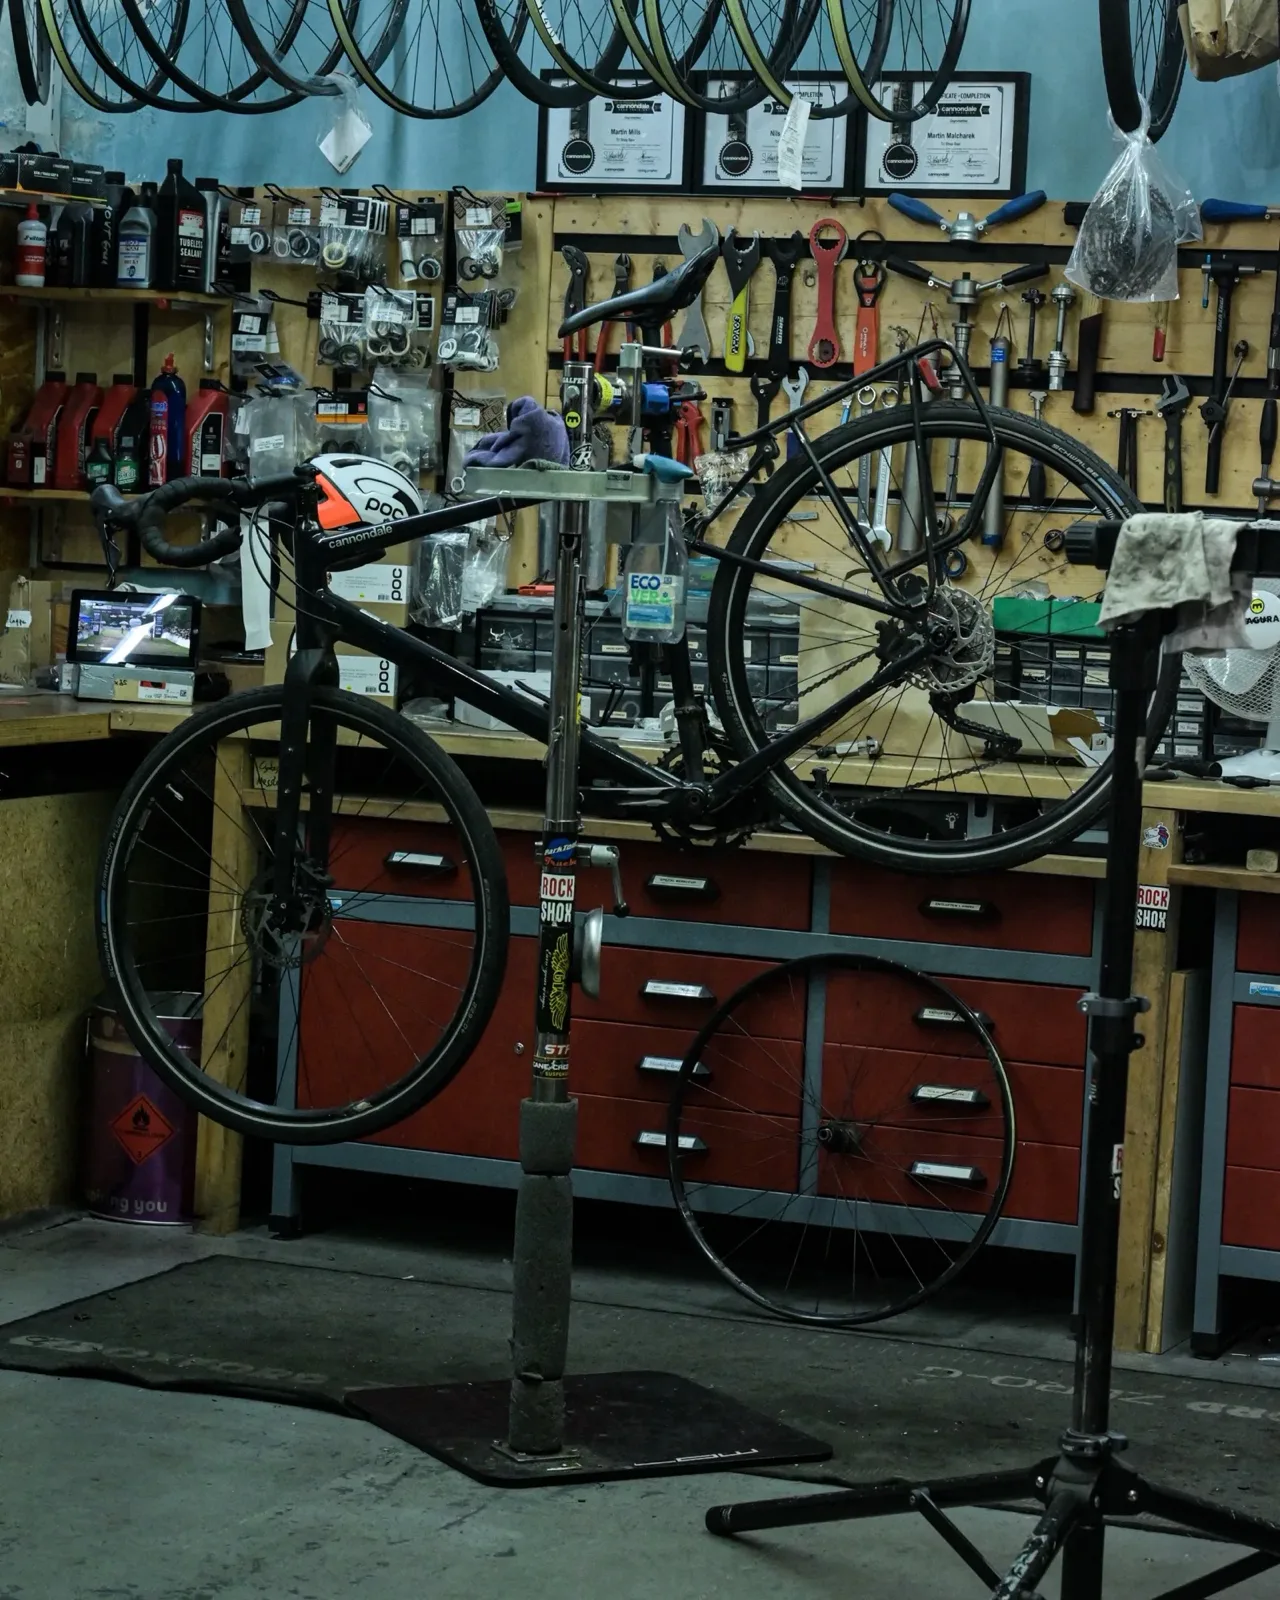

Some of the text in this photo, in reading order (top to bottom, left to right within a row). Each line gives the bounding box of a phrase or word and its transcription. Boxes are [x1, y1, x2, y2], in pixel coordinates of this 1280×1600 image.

[616, 102, 650, 110] cannondale
[179, 238, 203, 249] TUBELESS
[180, 249, 202, 258] SEALANT
[1051, 443, 1099, 479] SCHWALBE
[329, 524, 393, 549] cannondale
[631, 575, 661, 590] ECO
[542, 877, 573, 898] ROCK
[1137, 887, 1168, 907] ROCK
[540, 901, 573, 924] SHOX
[1136, 908, 1167, 928] SHOX
[134, 1198, 168, 1215] you
